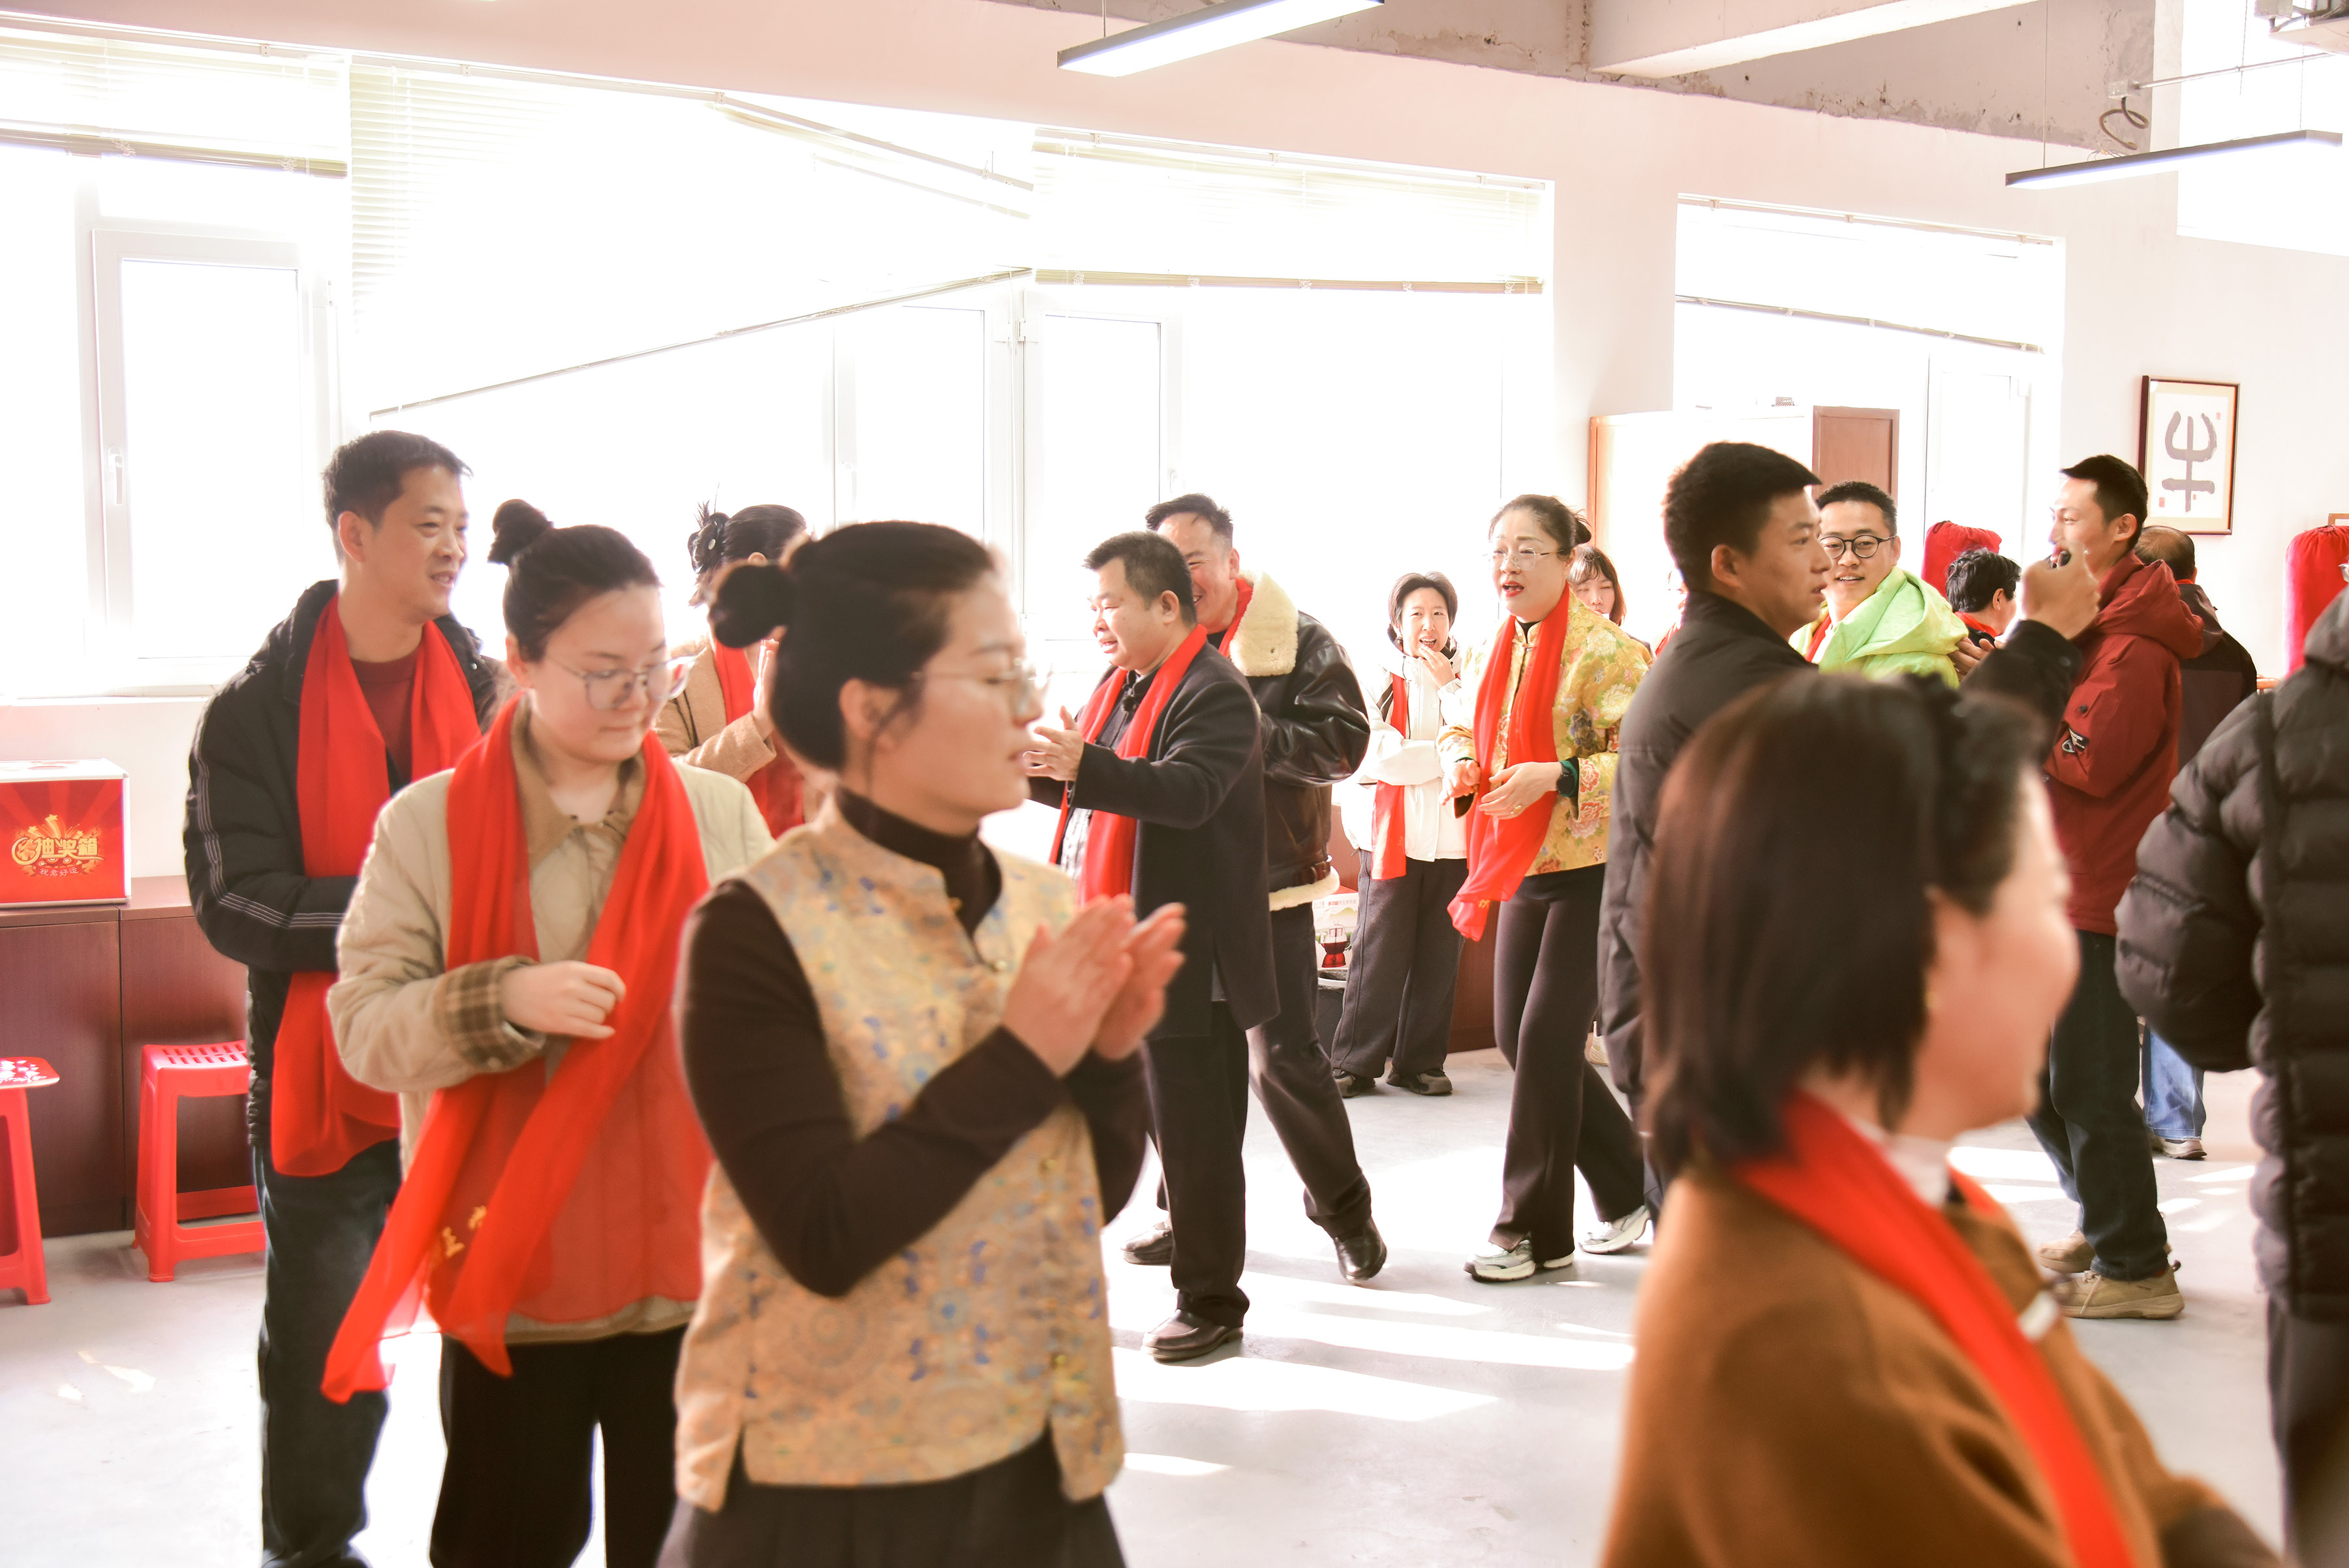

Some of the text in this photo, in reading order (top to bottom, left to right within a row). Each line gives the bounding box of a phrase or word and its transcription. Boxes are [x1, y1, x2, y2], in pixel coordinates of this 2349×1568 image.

[13, 837, 102, 865] 抽奖箱
[39, 866, 79, 876] 祝君好运
